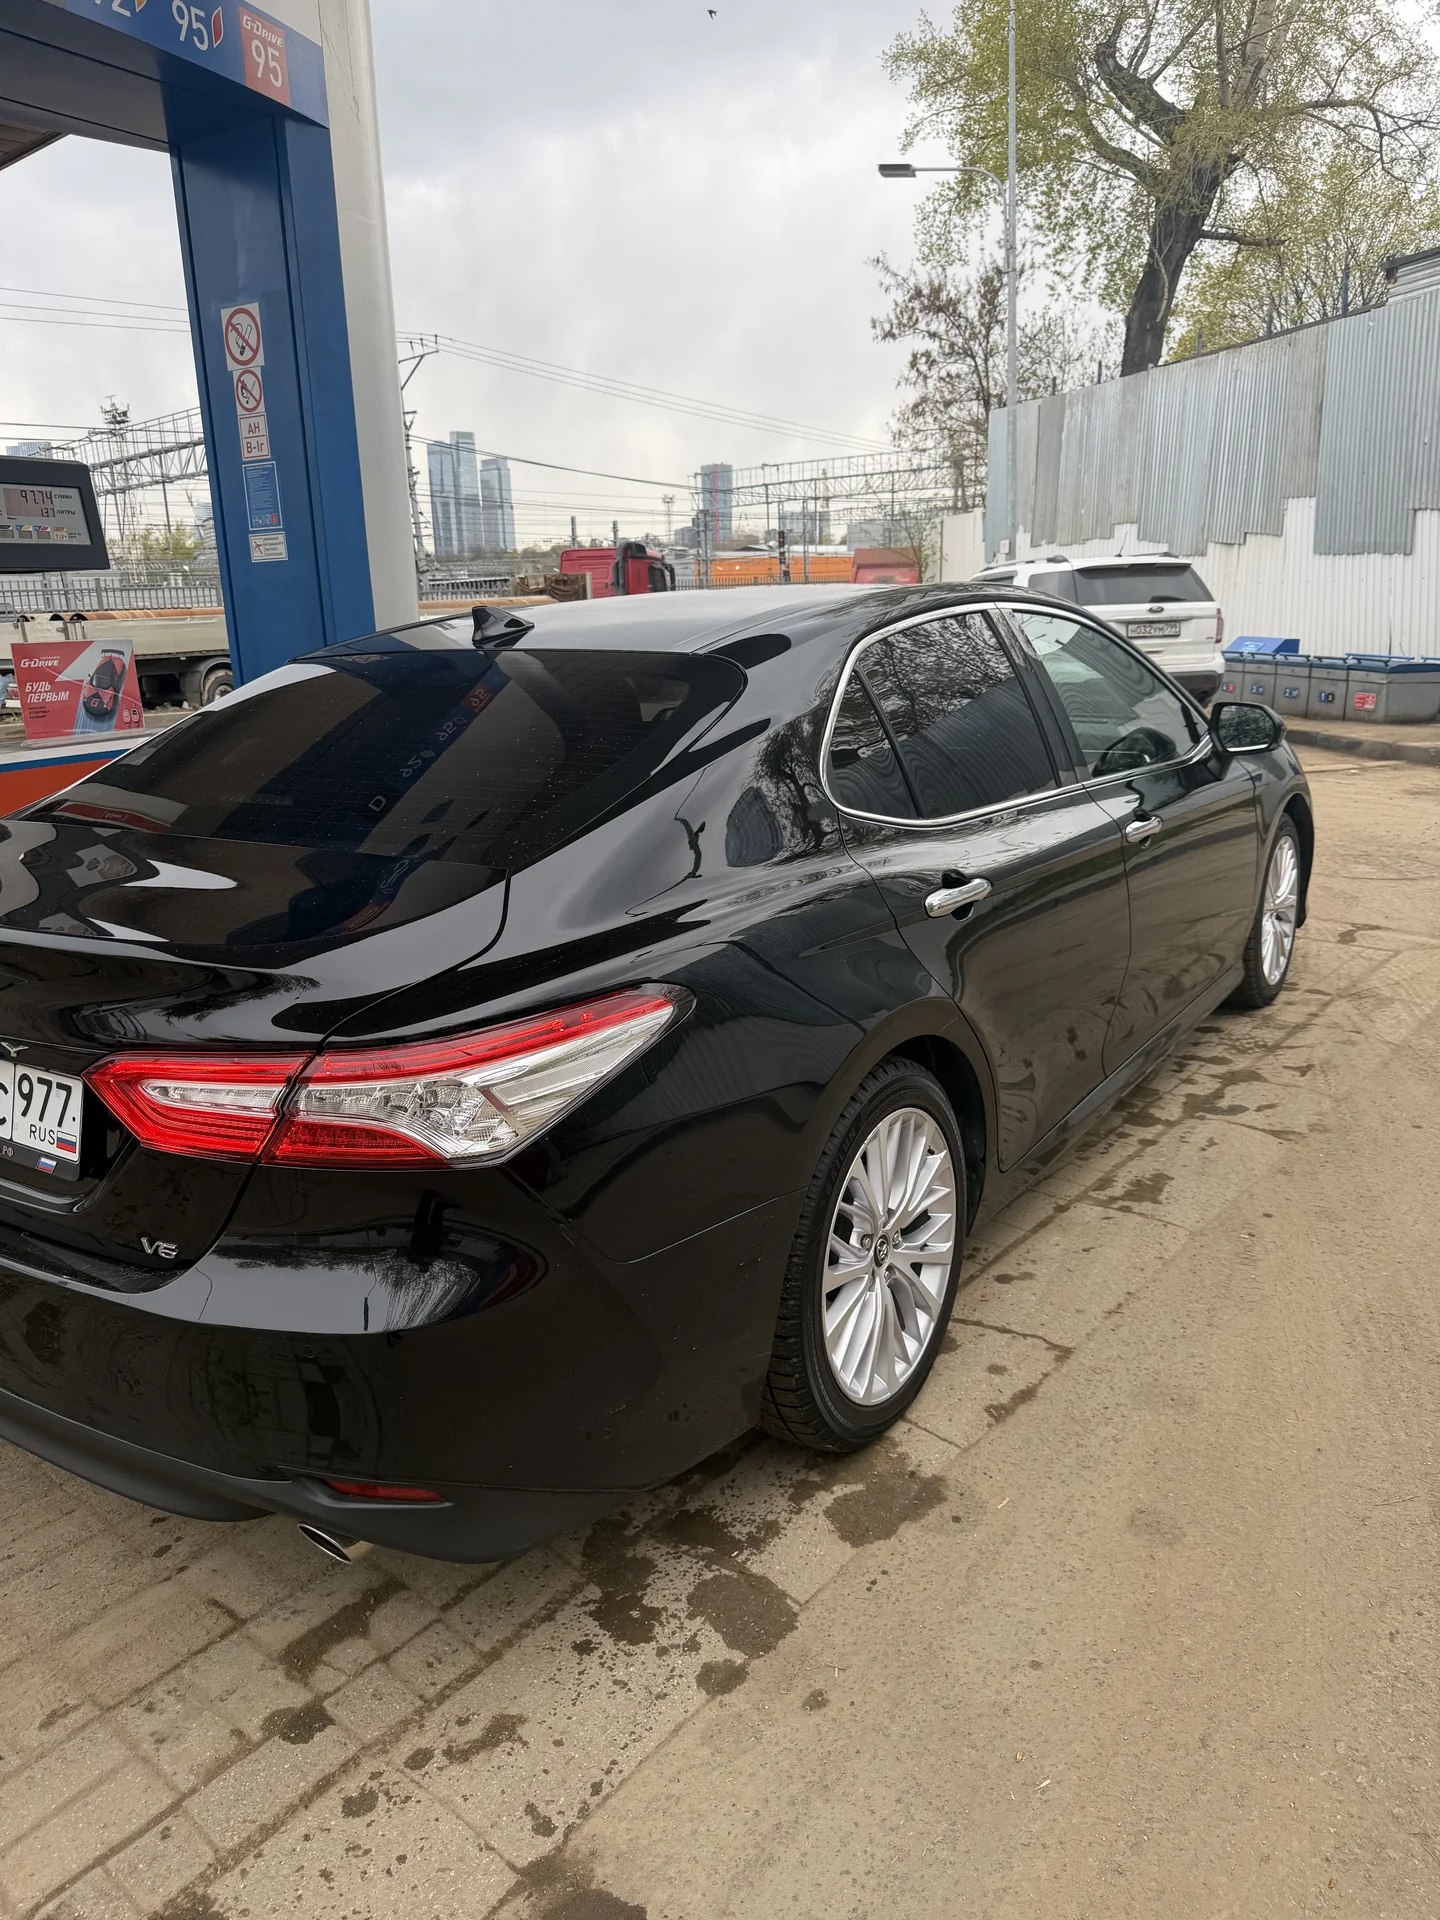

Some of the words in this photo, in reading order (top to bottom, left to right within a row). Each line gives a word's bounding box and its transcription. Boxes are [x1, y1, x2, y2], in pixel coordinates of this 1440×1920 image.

[172, 0, 209, 51] 95
[251, 39, 283, 88] 95
[25, 681, 51, 693] БУДЬ
[27, 691, 69, 703] ПЕРВЫМ
[17, 1073, 73, 1128] 977
[29, 1124, 56, 1146] RUS
[140, 1236, 179, 1260] V6
